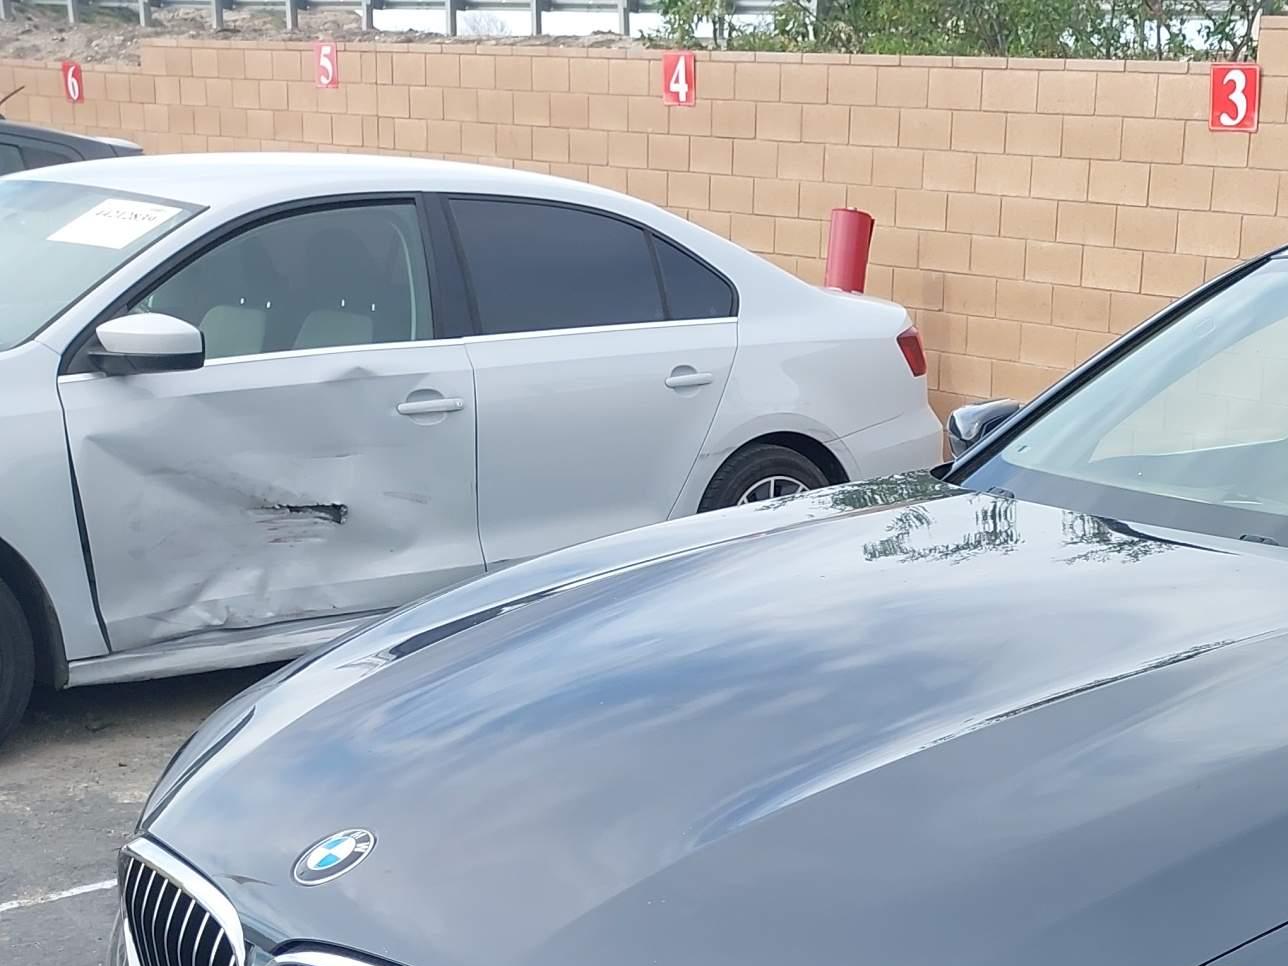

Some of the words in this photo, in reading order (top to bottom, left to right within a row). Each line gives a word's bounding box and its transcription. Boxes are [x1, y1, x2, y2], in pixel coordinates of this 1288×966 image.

[67, 66, 80, 99] 6
[318, 45, 333, 84] 5
[670, 55, 689, 102] 4
[1219, 69, 1247, 126] 3
